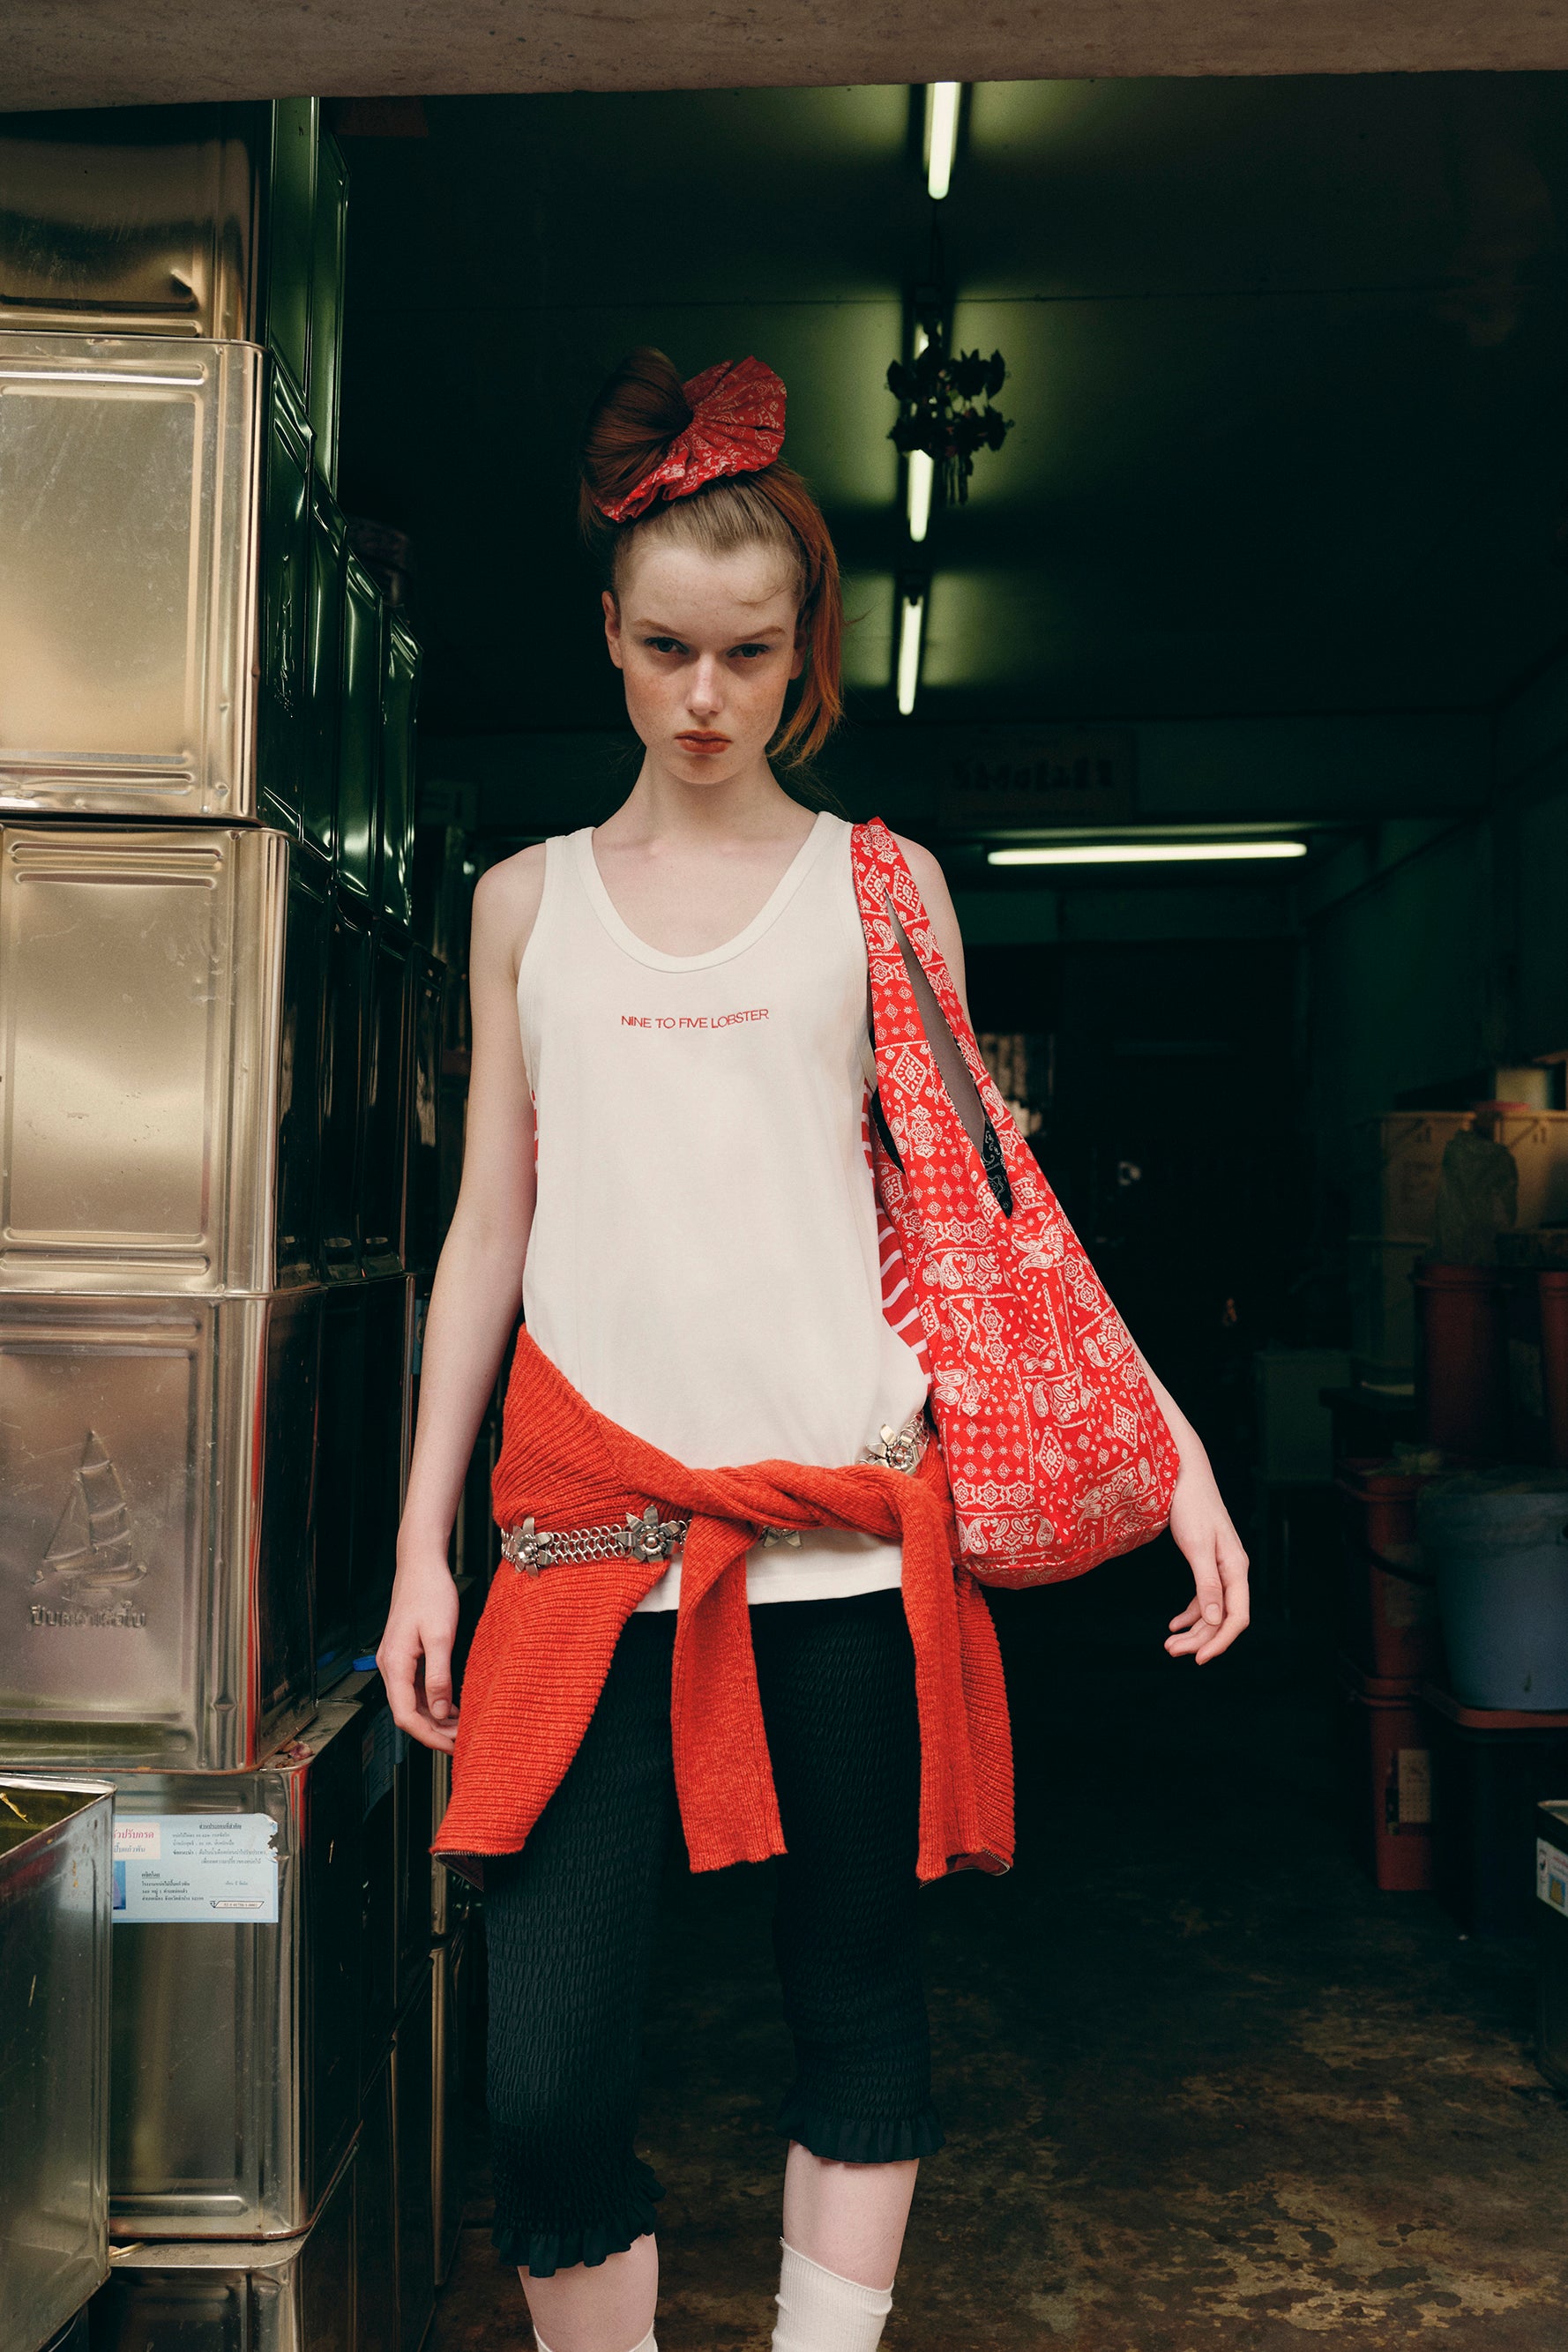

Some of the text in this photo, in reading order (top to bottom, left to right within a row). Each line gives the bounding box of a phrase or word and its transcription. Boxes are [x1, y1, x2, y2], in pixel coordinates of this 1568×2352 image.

[621, 1008, 769, 1029] NINE TO FIVE LOBSTER
